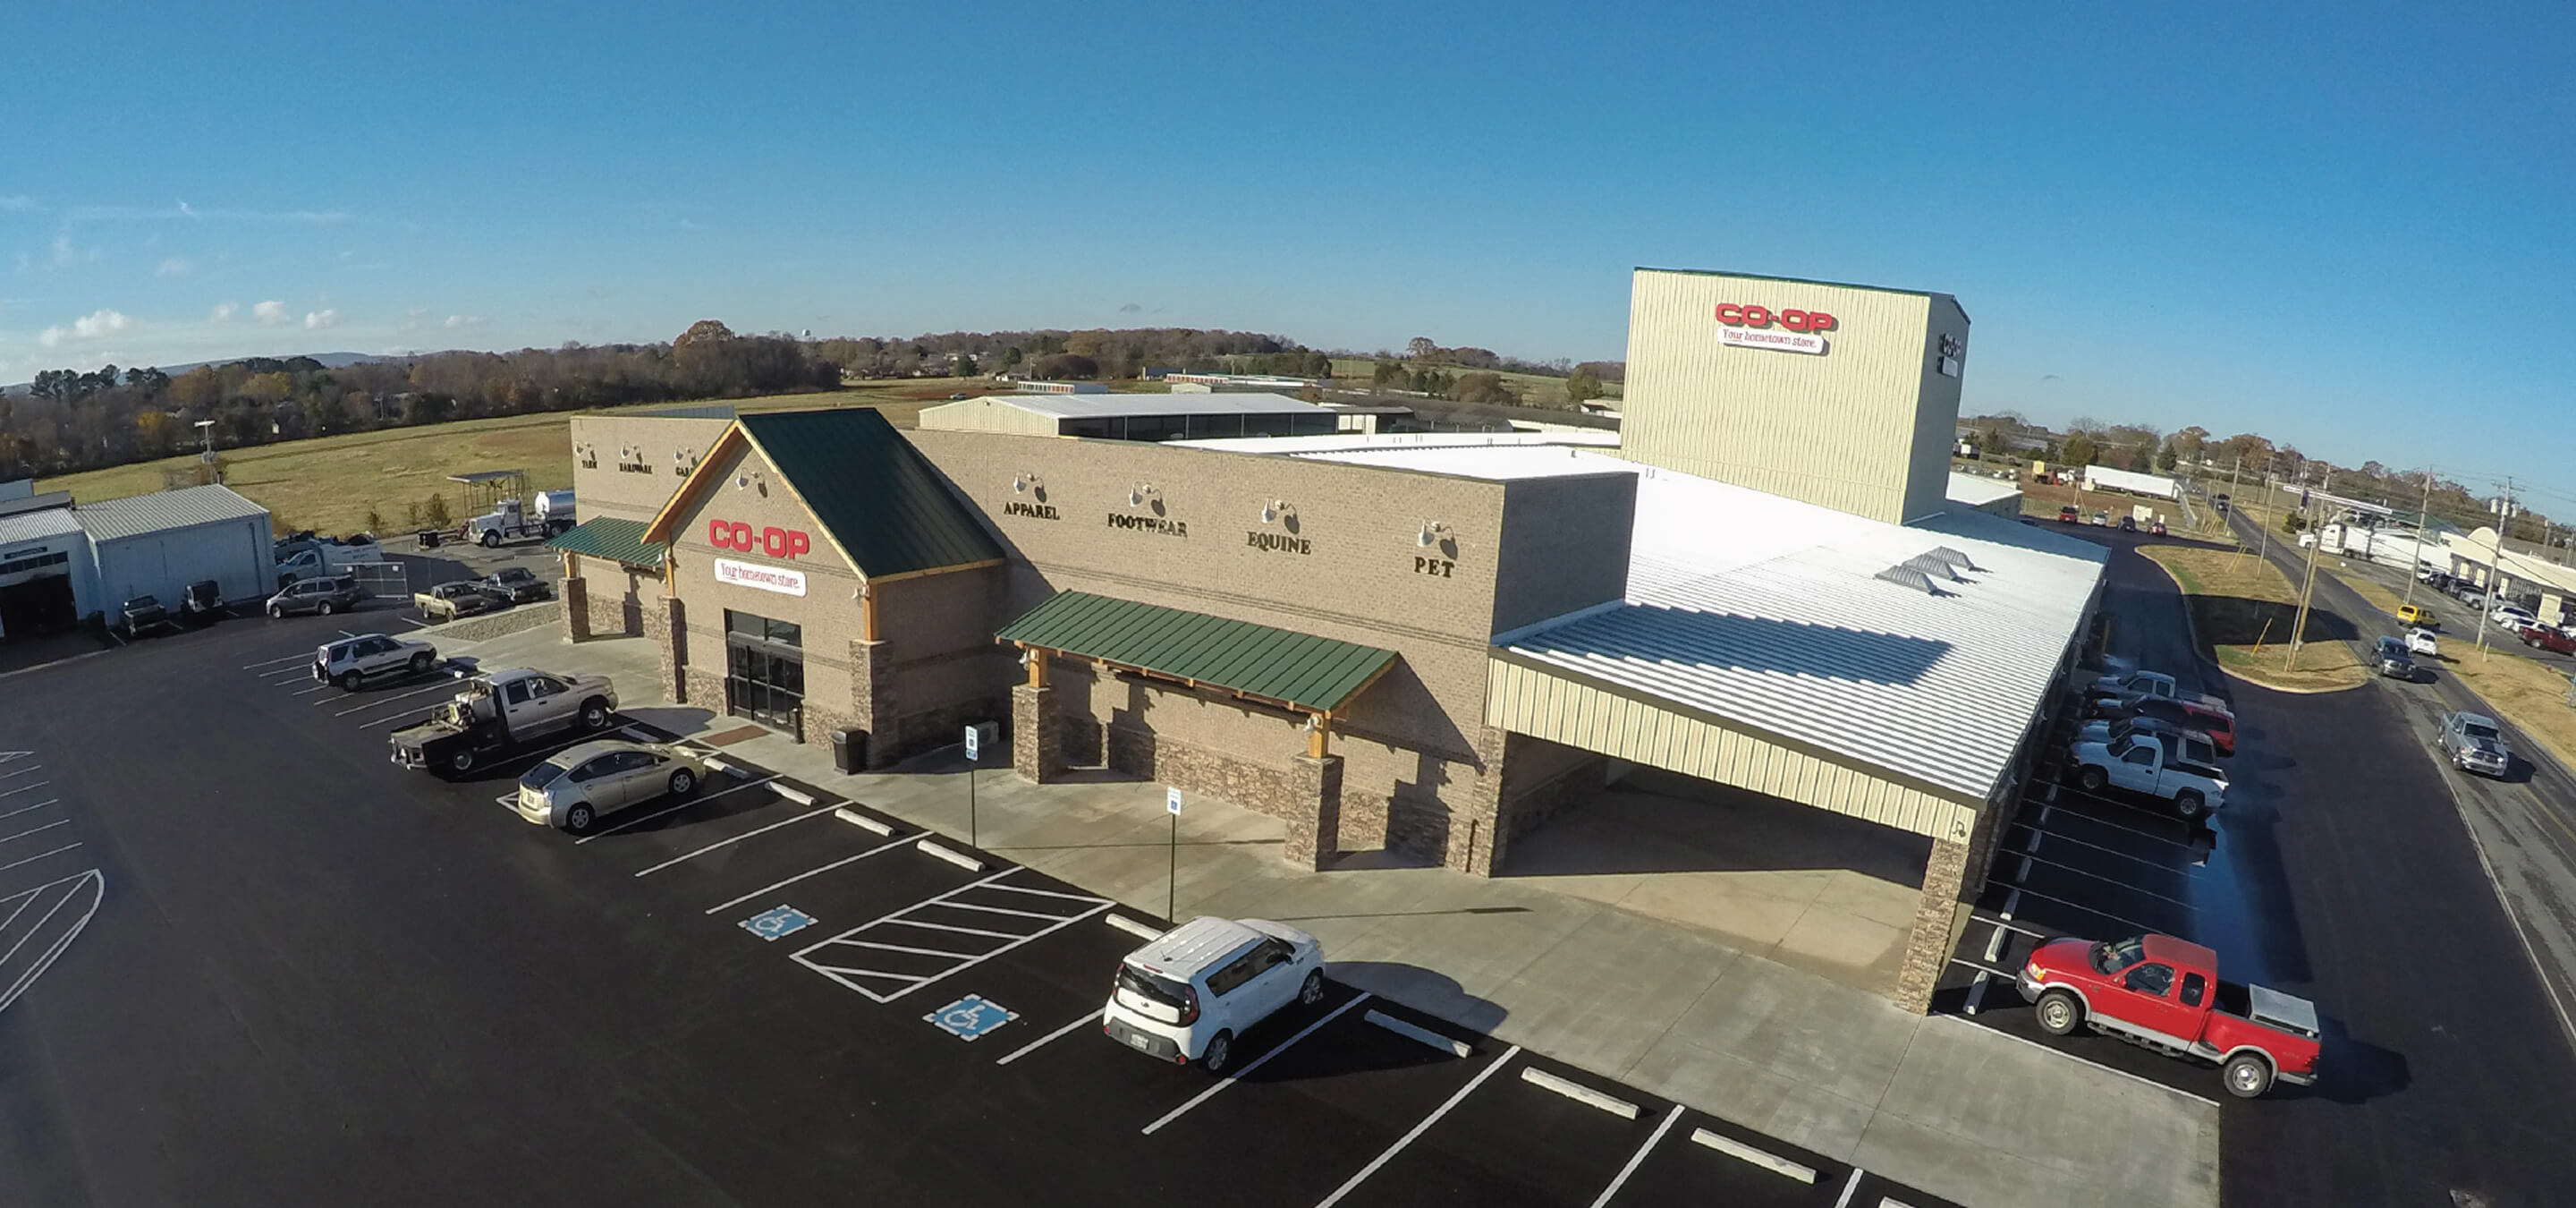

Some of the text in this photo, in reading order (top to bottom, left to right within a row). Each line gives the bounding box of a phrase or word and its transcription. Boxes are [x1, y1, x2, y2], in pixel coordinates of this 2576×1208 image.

[1716, 302, 1833, 332] CO-OP
[1723, 328, 1743, 341] Your
[1744, 331, 1791, 345] hometown
[619, 463, 653, 475] HARDWARE
[1004, 501, 1060, 521] APPAREL
[1107, 513, 1188, 539] FOOTWEAR
[709, 519, 809, 561] CO-OP
[1246, 531, 1312, 556] EQUINE
[721, 563, 738, 580] Your
[738, 565, 776, 586] hometown
[1414, 557, 1455, 578] PET
